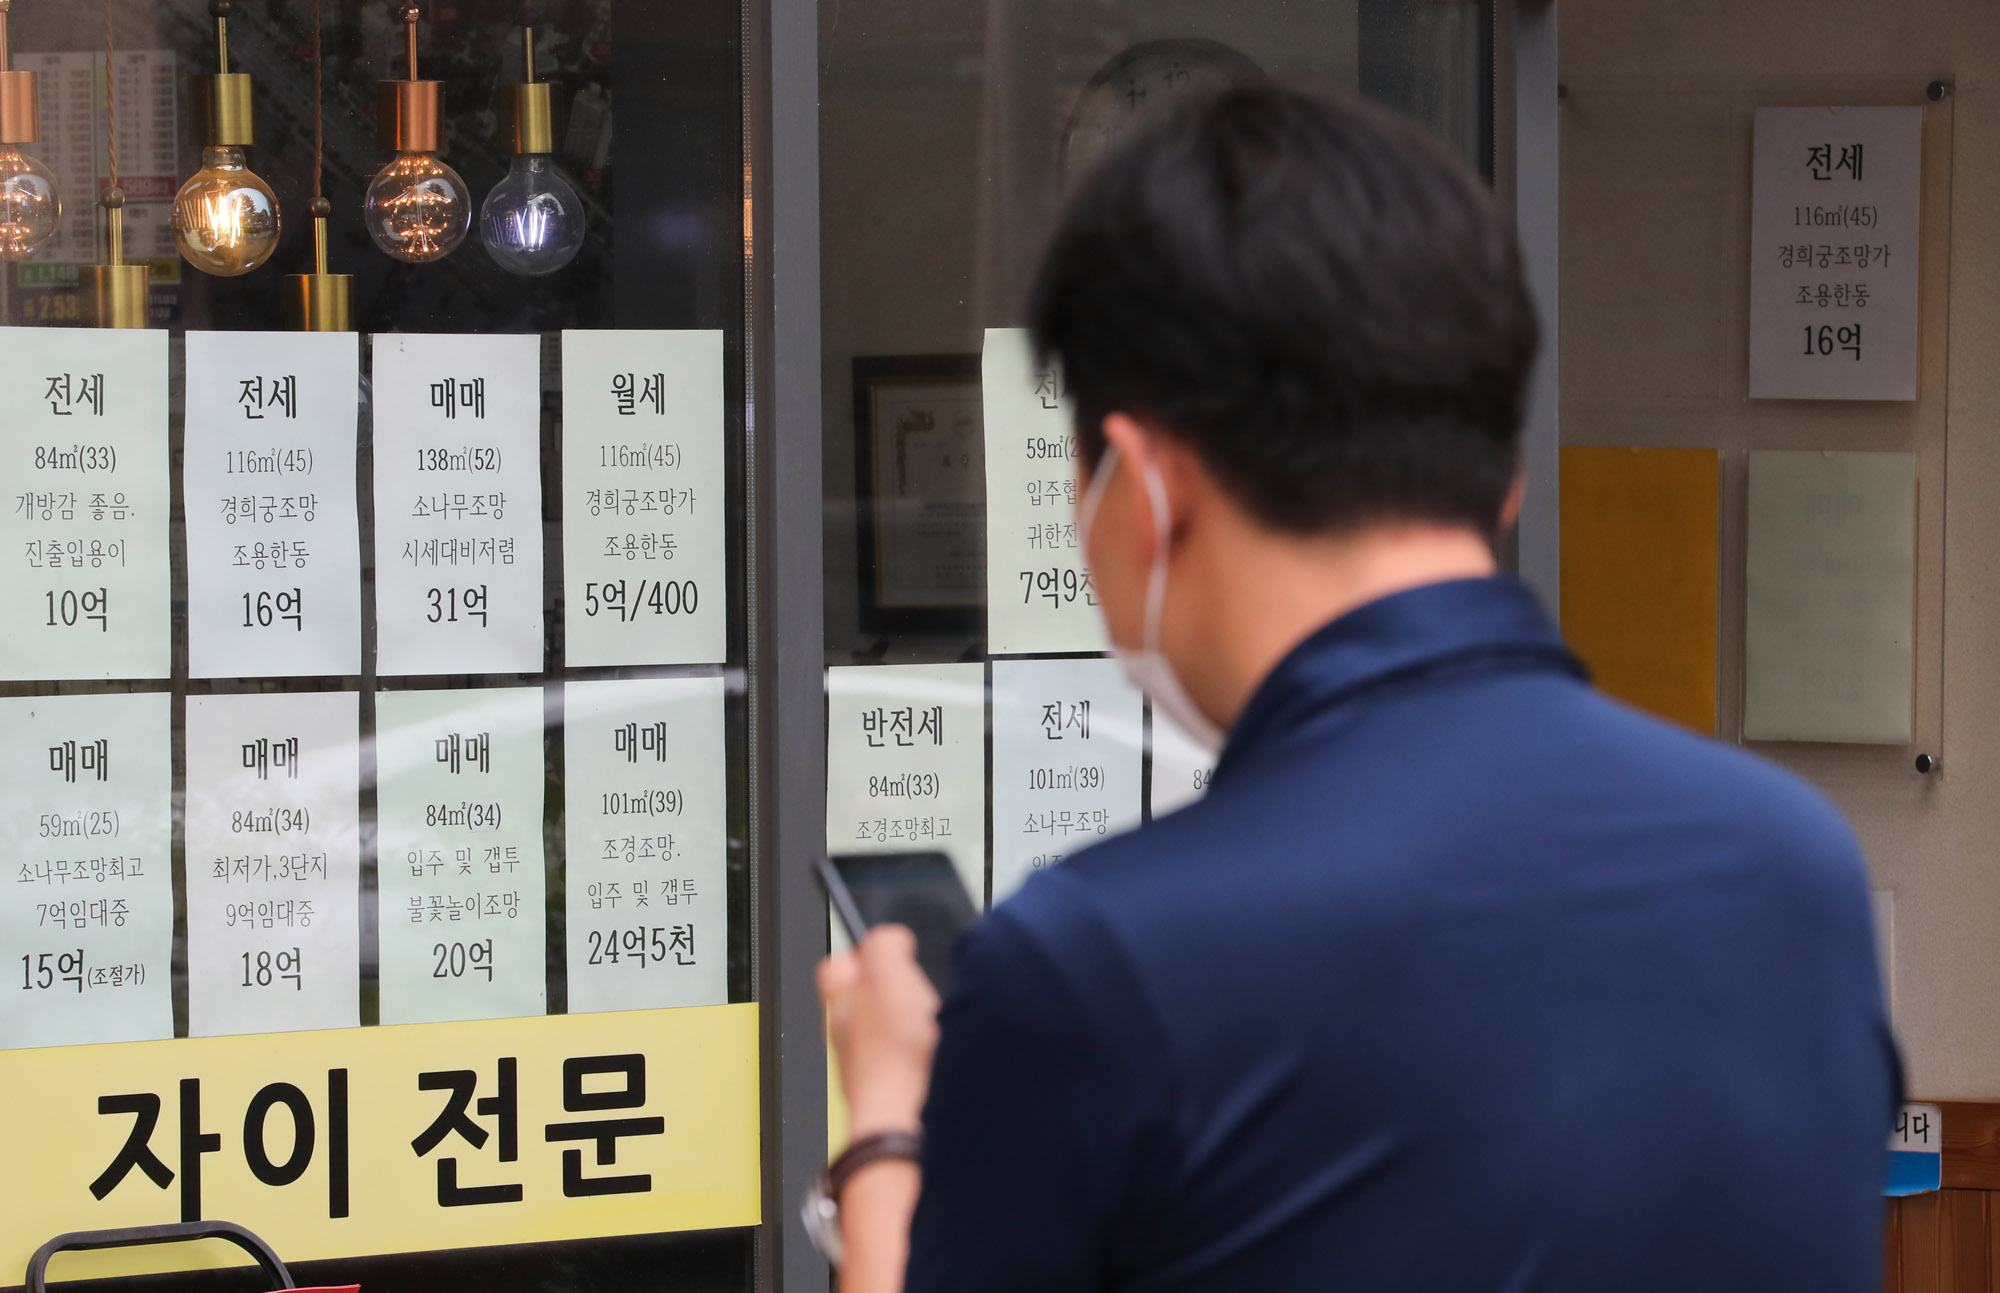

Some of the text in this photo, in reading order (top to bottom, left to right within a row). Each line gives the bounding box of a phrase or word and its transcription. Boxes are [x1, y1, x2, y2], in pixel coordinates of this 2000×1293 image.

[1806, 144, 1863, 181] 전세
[1795, 205, 1877, 229] 116㎡(45)
[1778, 244, 1891, 269] 경희궁조망가
[1795, 283, 1871, 308] 조용한동
[1804, 323, 1860, 361] 16억
[45, 373, 104, 416] 전세
[239, 375, 296, 419] 전세
[430, 377, 484, 419] 매매
[611, 373, 664, 415] 월세
[1035, 369, 1068, 410] 전
[35, 445, 116, 473] 84㎡(33)
[227, 448, 312, 476] 116㎡(45)
[418, 448, 501, 474] 138㎡(52)
[601, 443, 680, 470] 116㎡(45)
[1026, 435, 1079, 462] 59㎡(2
[16, 492, 134, 521] 개방감 좋음.
[412, 492, 507, 520] 소나무조망
[586, 488, 696, 516] 경희궁조망가
[1026, 479, 1077, 506] 입주협
[221, 494, 318, 524] 경희궁조망
[604, 533, 677, 560] 조용한동
[1026, 521, 1078, 550] 귀한전
[25, 539, 124, 568] 진출입용이
[232, 541, 310, 570] 조용한동
[402, 537, 513, 566] 시세대비저렴
[46, 588, 106, 632] 10억
[243, 588, 301, 631] 16억
[427, 585, 487, 628] 31억
[586, 580, 698, 622] 5억/400
[862, 706, 942, 747] 반전세
[1041, 700, 1090, 740] 전세
[436, 732, 489, 774] 매매
[615, 722, 666, 763] 매매
[49, 739, 107, 783] 매매
[242, 737, 298, 780] 매매
[869, 773, 939, 800] 84㎡(33)
[1030, 766, 1104, 792] 101㎡(39)
[427, 802, 501, 830] 84㎡(34)
[603, 789, 682, 817] 101㎡(39)
[40, 810, 119, 839] 59㎡(25)
[232, 808, 309, 835] 84㎡(34)
[856, 816, 952, 842] 조경조망최고
[1023, 808, 1109, 836] 소나무조망
[408, 846, 520, 876] 입주 및 갭투
[602, 834, 680, 863] 조경조망.
[17, 856, 144, 885] 소나무조망최고
[213, 853, 326, 884] 최저가,3단지
[408, 891, 520, 922] 불꽃놀이조망
[588, 879, 698, 909] 입주 및 갭투
[37, 899, 129, 929] 7억임대중
[226, 900, 315, 929] 9억임대중
[433, 939, 492, 982] 20억
[589, 924, 696, 968] 24억5천
[22, 949, 144, 993] 15억(조절가)
[242, 947, 301, 991] 18억
[89, 1053, 665, 1222] 자이 전문
[1895, 1112, 1930, 1144] 니다
